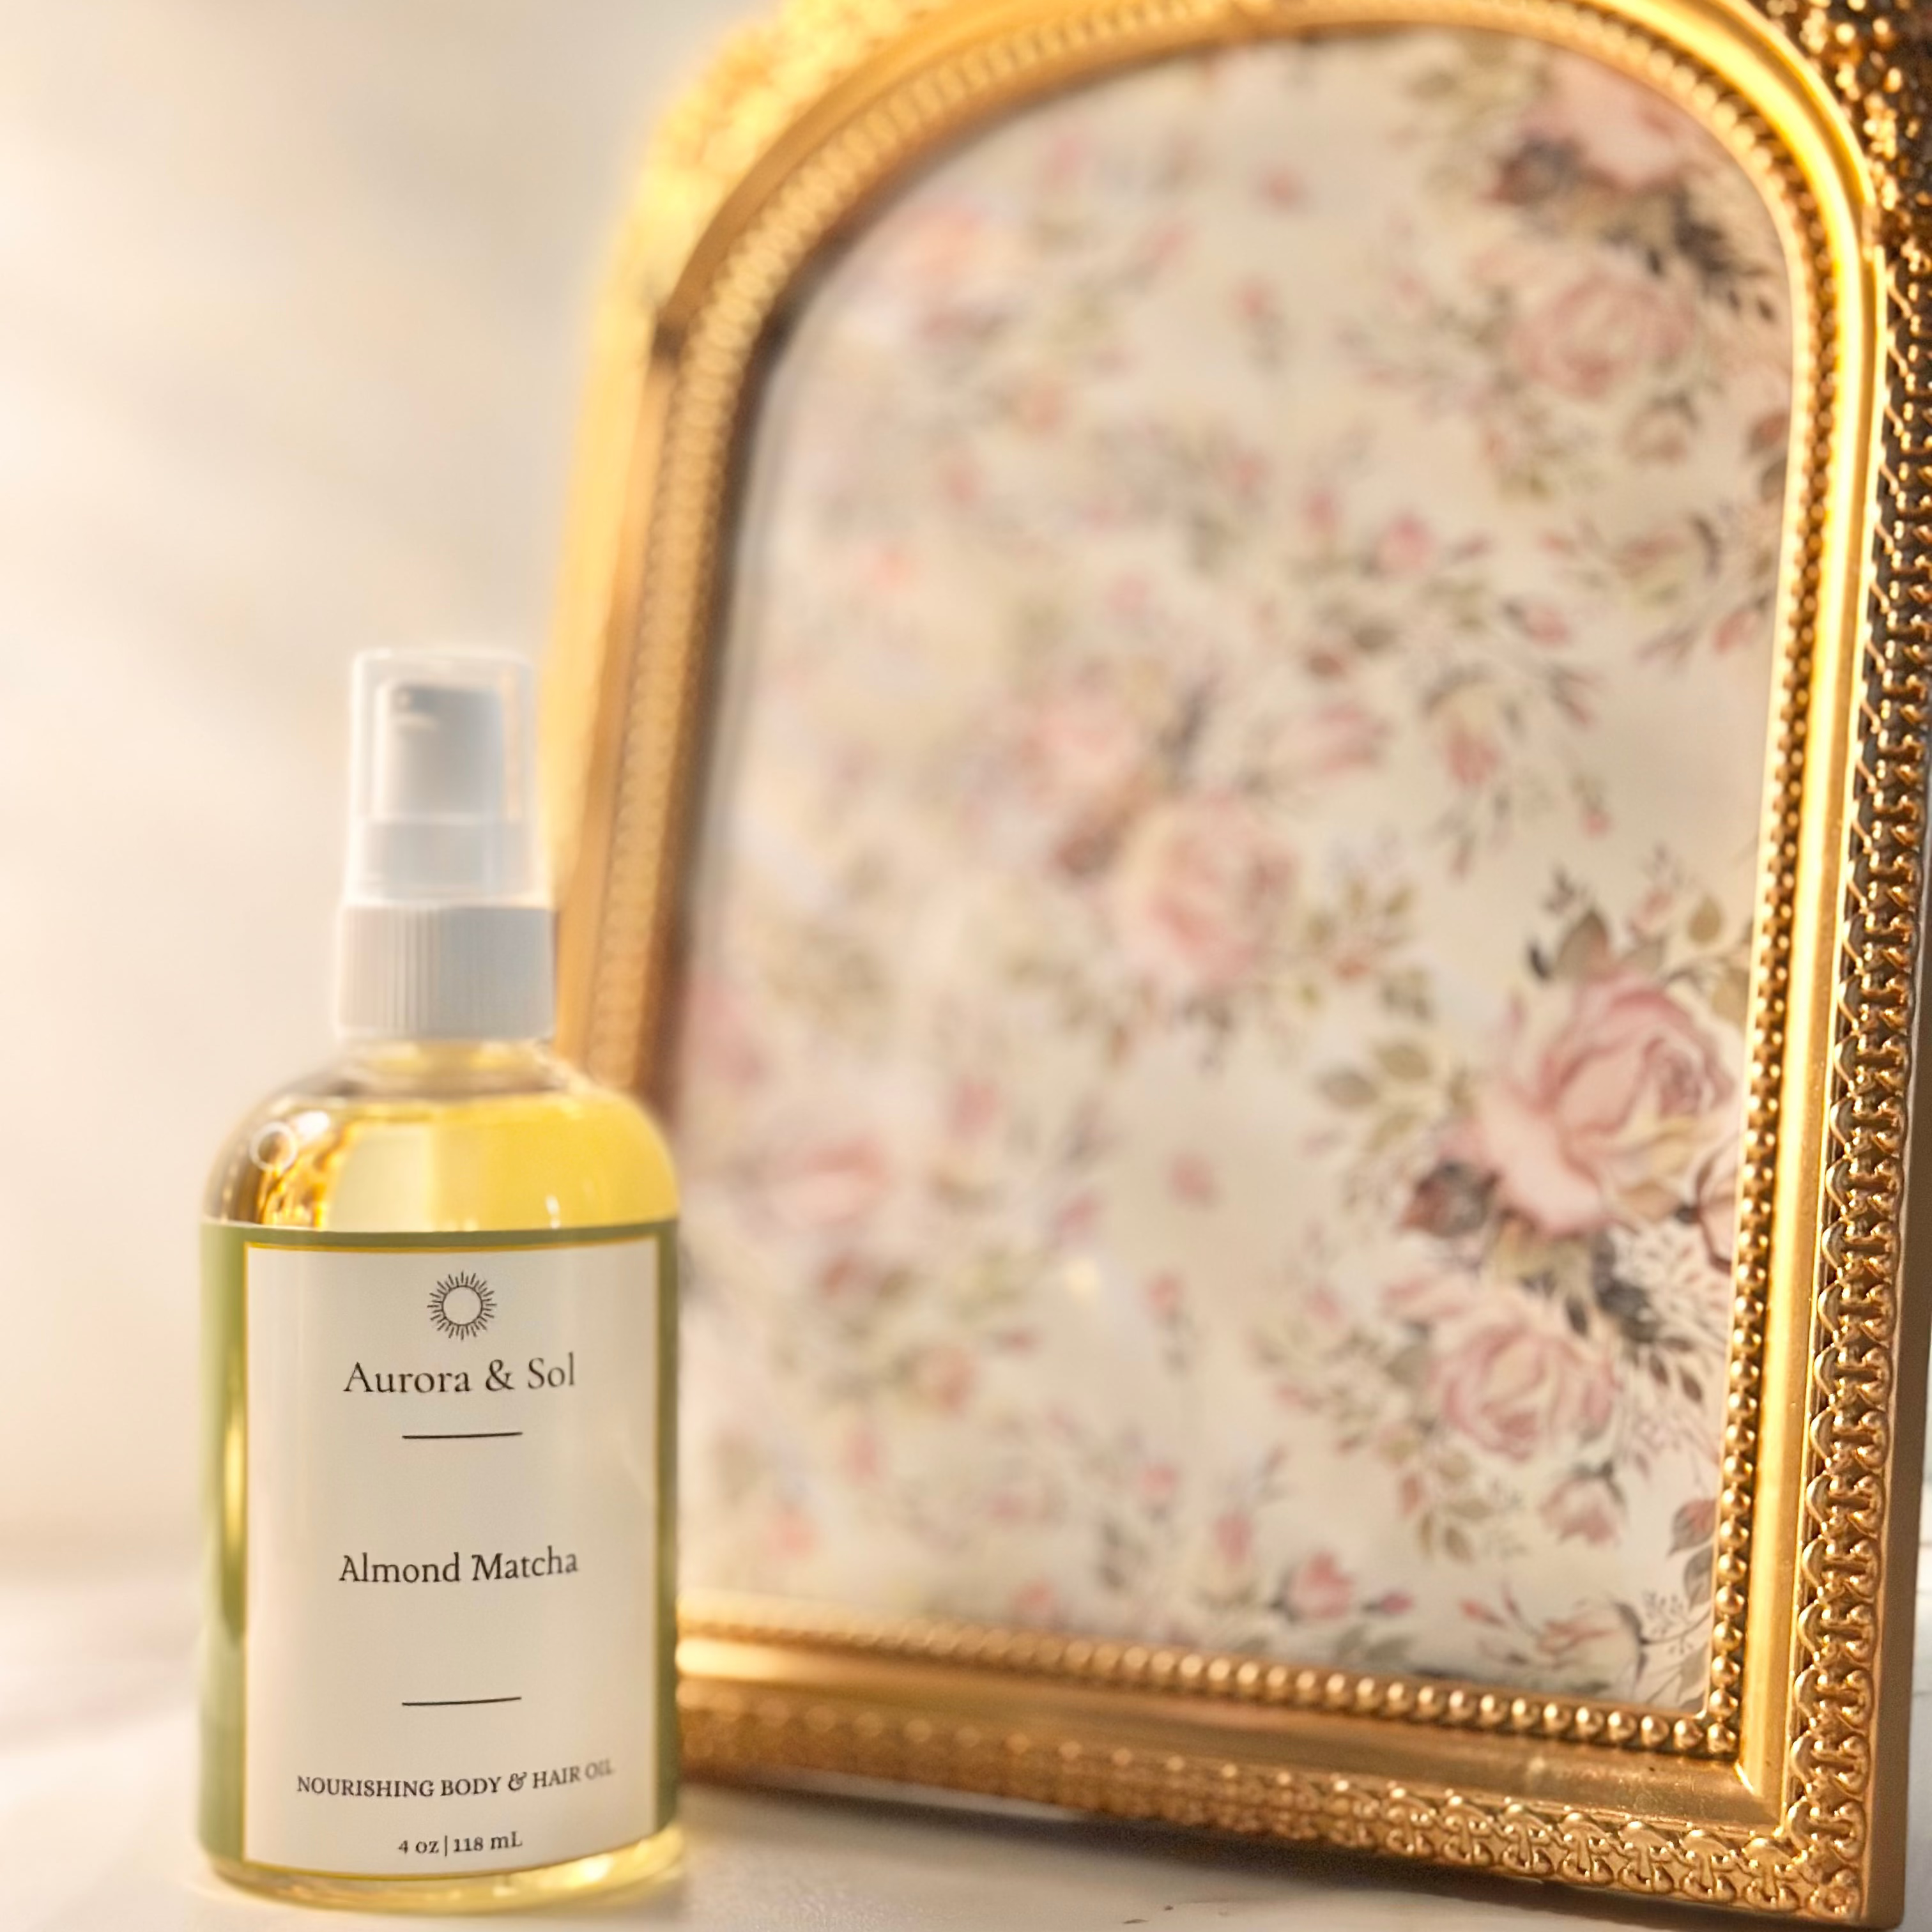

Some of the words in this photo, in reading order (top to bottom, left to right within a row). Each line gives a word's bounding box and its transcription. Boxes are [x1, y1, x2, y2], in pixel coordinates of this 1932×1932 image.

[342, 1361, 472, 1395] Aurora
[484, 1359, 516, 1393] &
[528, 1351, 575, 1390] Sol
[339, 1551, 461, 1584] Almond
[471, 1545, 579, 1582] Matcha
[296, 1775, 435, 1798] NOURISHING
[440, 1775, 502, 1797] BODY
[507, 1771, 527, 1792] &
[532, 1765, 581, 1790] HAIR
[584, 1758, 614, 1781] OIL
[397, 1839, 409, 1854] 4
[490, 1830, 523, 1850] mL
